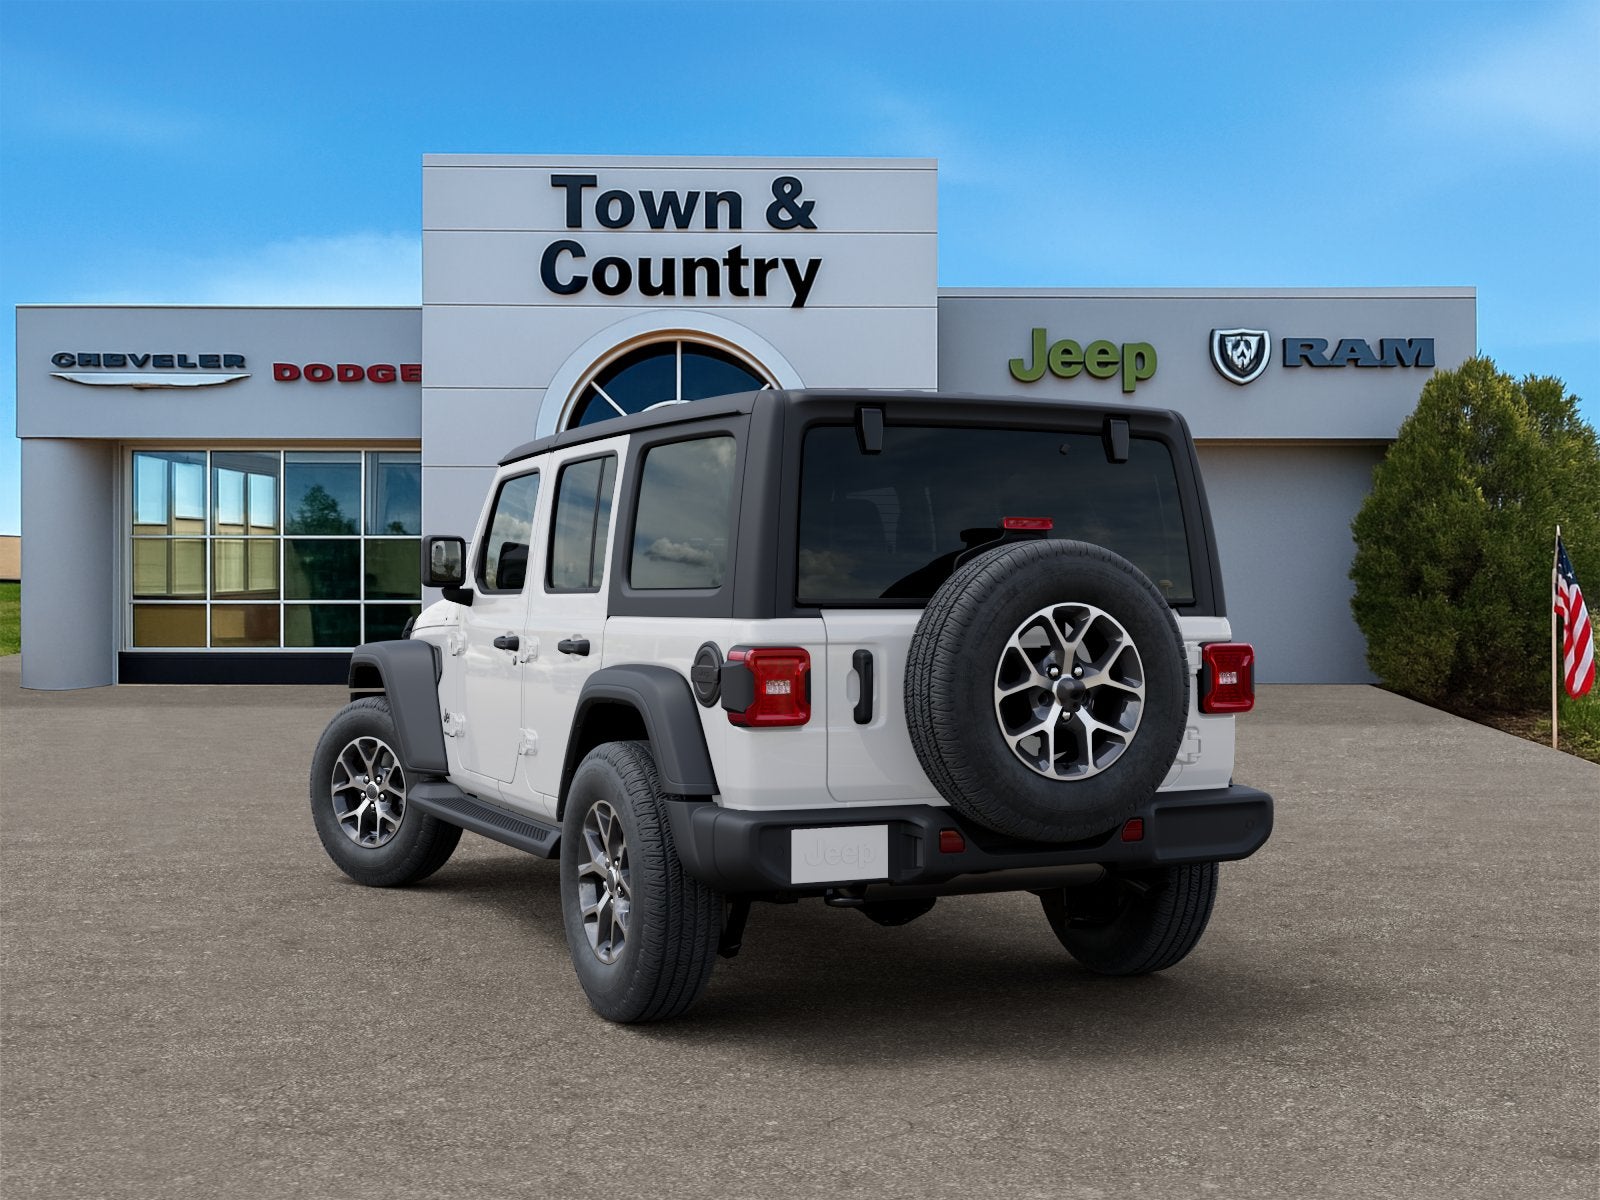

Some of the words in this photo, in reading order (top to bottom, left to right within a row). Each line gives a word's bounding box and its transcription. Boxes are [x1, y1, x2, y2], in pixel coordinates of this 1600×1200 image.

[551, 174, 742, 229] Town
[766, 176, 818, 230] &
[540, 240, 822, 308] Country
[273, 363, 422, 383] DODGE
[1009, 328, 1157, 392] Jeep
[1283, 337, 1435, 367] RAM
[803, 839, 877, 869] Jeep
